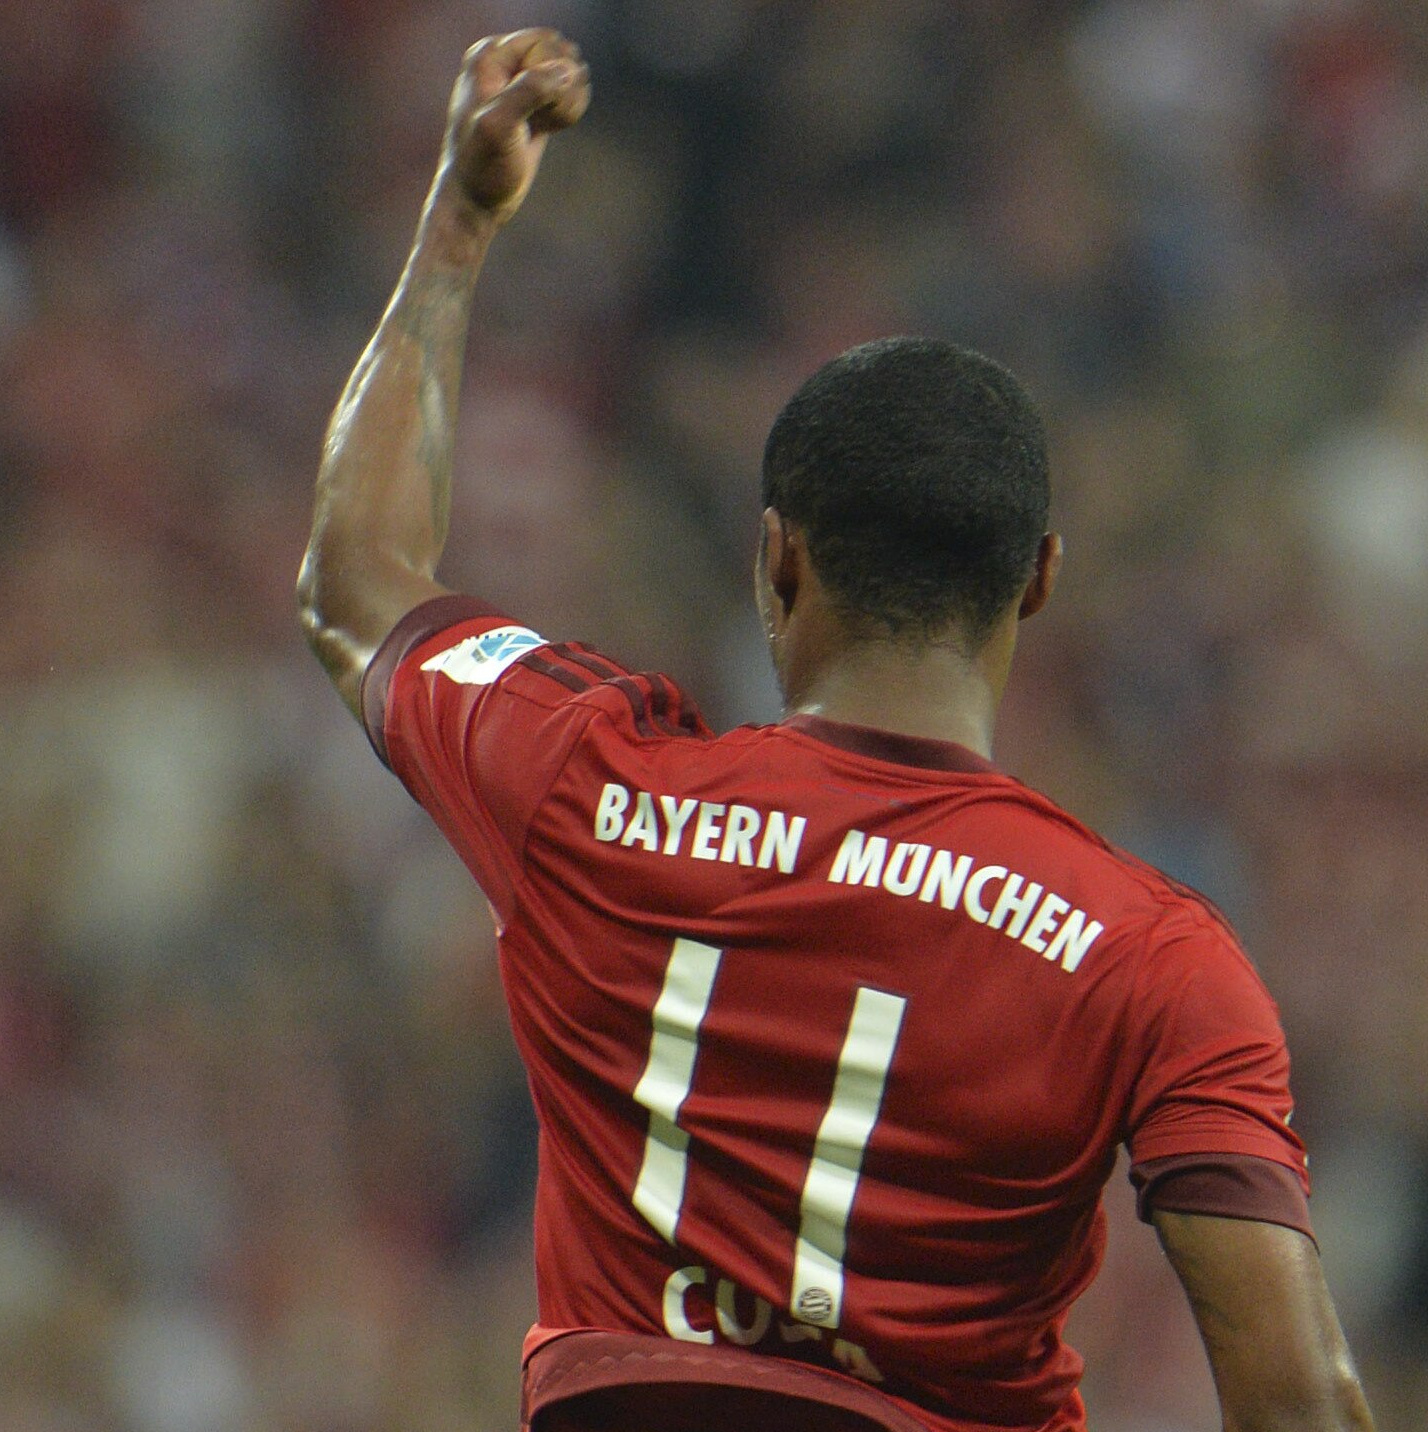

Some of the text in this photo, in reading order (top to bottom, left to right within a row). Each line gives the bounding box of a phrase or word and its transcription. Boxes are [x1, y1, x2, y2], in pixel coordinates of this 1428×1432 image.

[595, 783, 1105, 974] BAYERN MÜNCHEN
[632, 937, 907, 1330] 11
